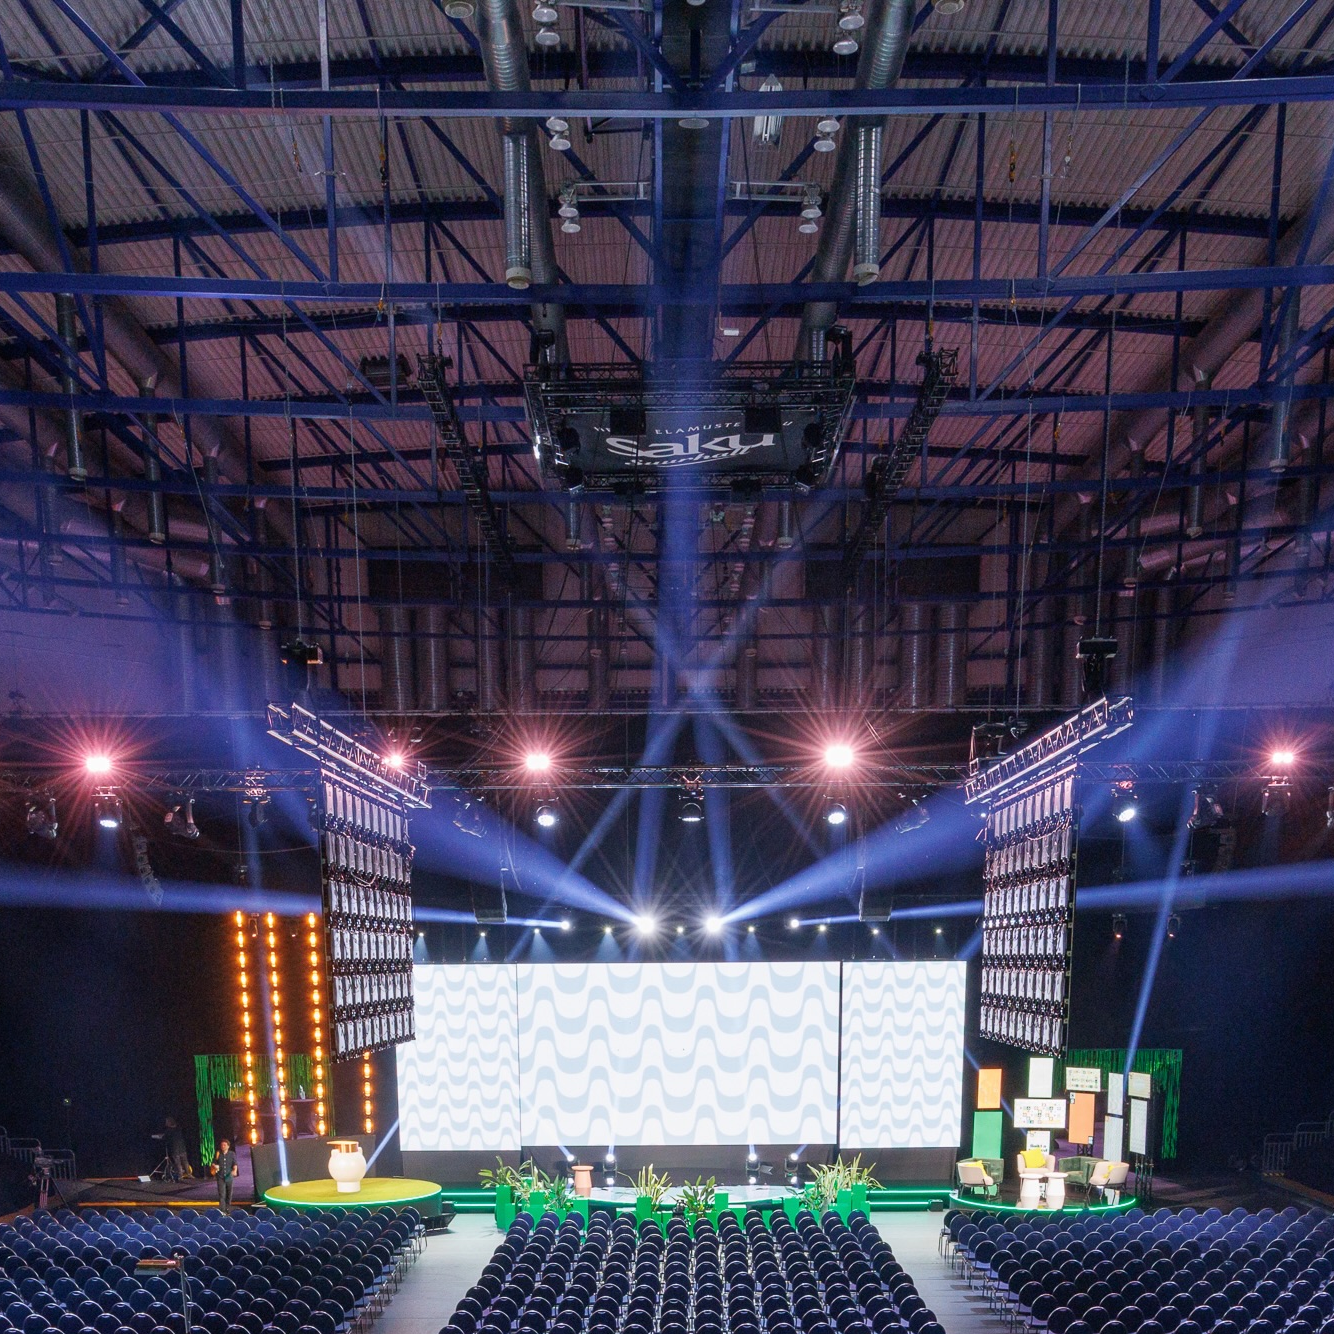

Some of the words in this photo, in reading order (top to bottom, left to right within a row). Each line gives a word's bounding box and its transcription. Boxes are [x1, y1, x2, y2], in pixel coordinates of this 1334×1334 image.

[655, 421, 741, 435] ELAMUSTE
[605, 433, 777, 458] Saku
[624, 446, 751, 466] Suurhall
